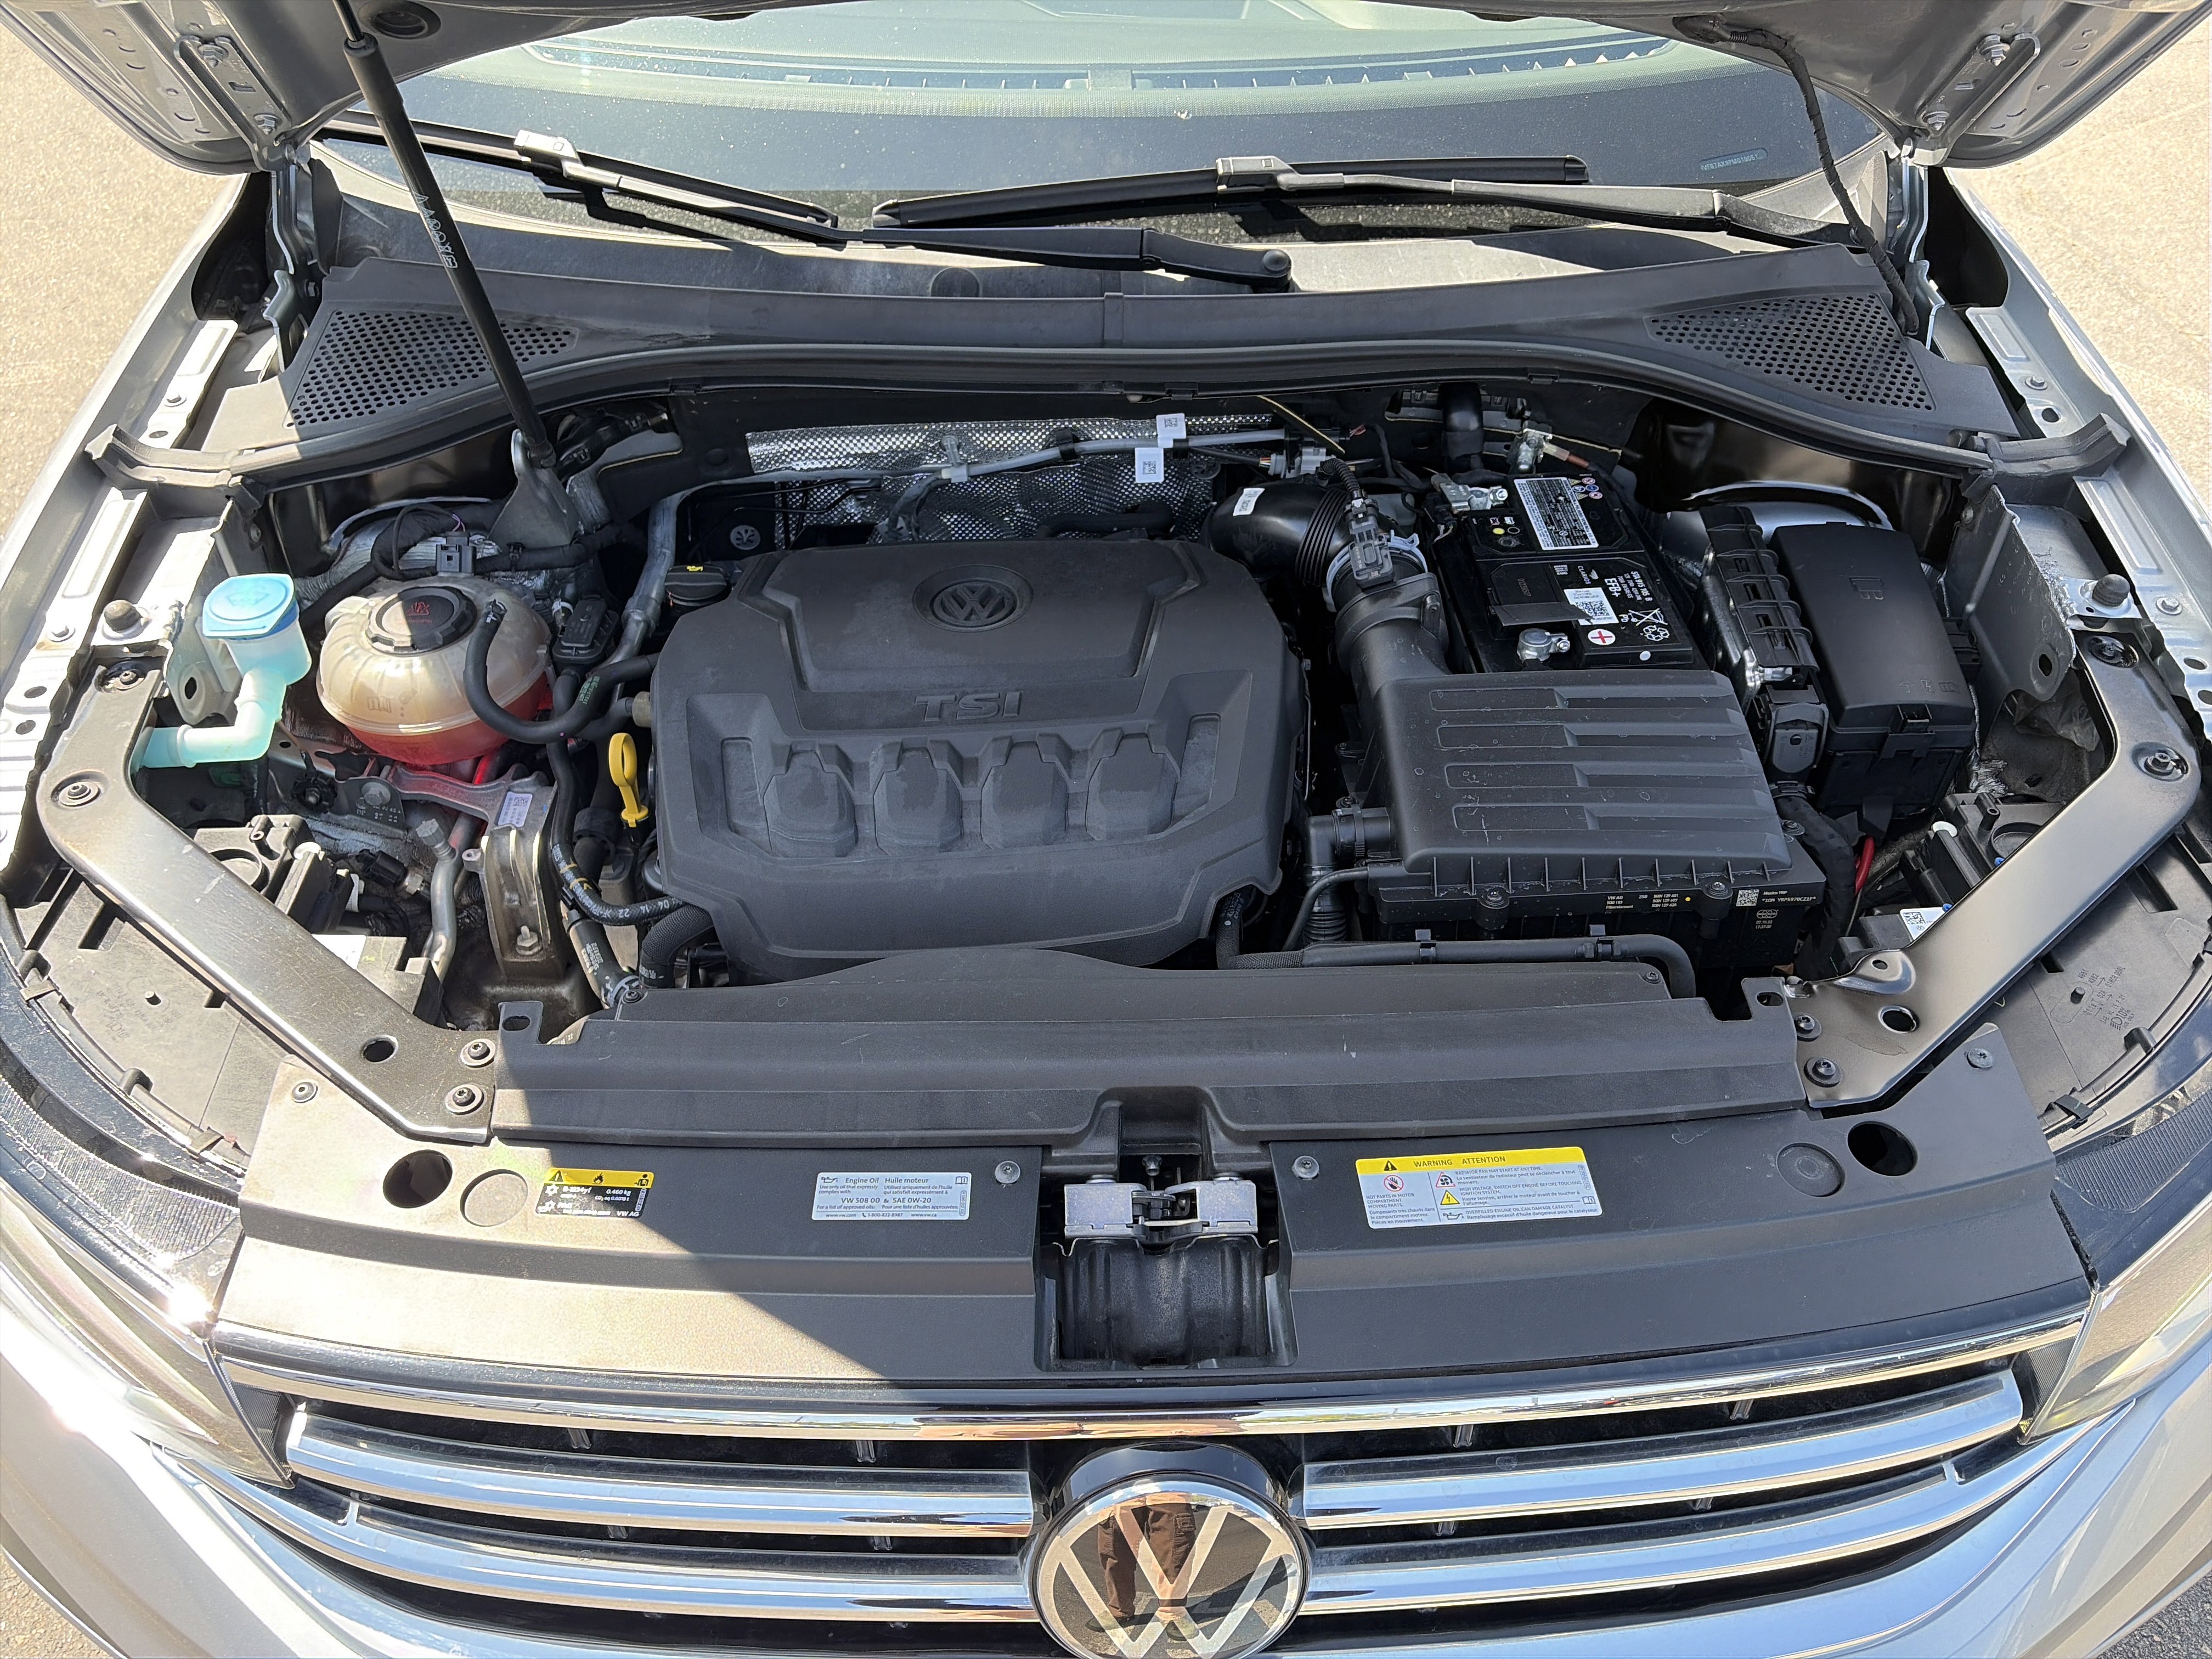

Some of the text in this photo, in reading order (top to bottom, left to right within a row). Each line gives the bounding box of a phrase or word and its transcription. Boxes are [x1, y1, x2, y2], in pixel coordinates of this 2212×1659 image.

[1577, 565, 1592, 585] CLARIOS
[1604, 578, 1621, 597] EFB+
[933, 580, 1016, 627] VW
[914, 691, 1023, 721] TSI
[618, 909, 630, 918] 22
[1413, 1156, 1506, 1167] WARNING ATTENTION
[1040, 1481, 1298, 1659] VW
